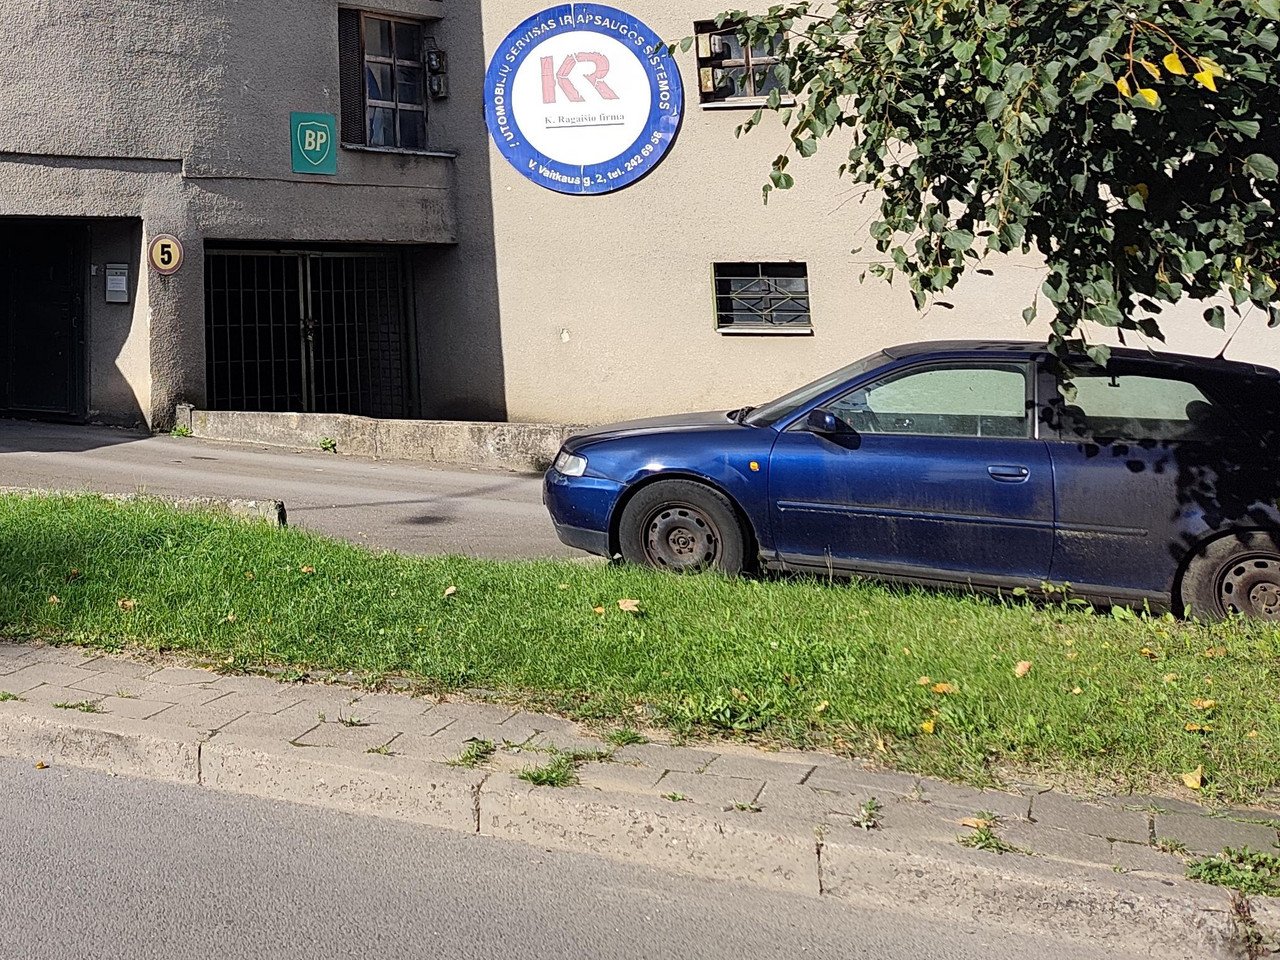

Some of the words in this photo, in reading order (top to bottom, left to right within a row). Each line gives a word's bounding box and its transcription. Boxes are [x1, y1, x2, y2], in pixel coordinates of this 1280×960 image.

[505, 19, 557, 63] SERVISAS
[559, 14, 573, 26] IR
[576, 14, 645, 46] APSAUGOS
[540, 51, 620, 104] KR
[545, 116, 556, 124] K.
[599, 112, 625, 122] firma
[304, 129, 327, 151] BP
[527, 158, 538, 171] V.
[583, 176, 595, 187] g.
[595, 174, 607, 184] 2,
[607, 168, 625, 181] tel.
[624, 154, 644, 172] 242
[160, 243, 173, 266] 5
